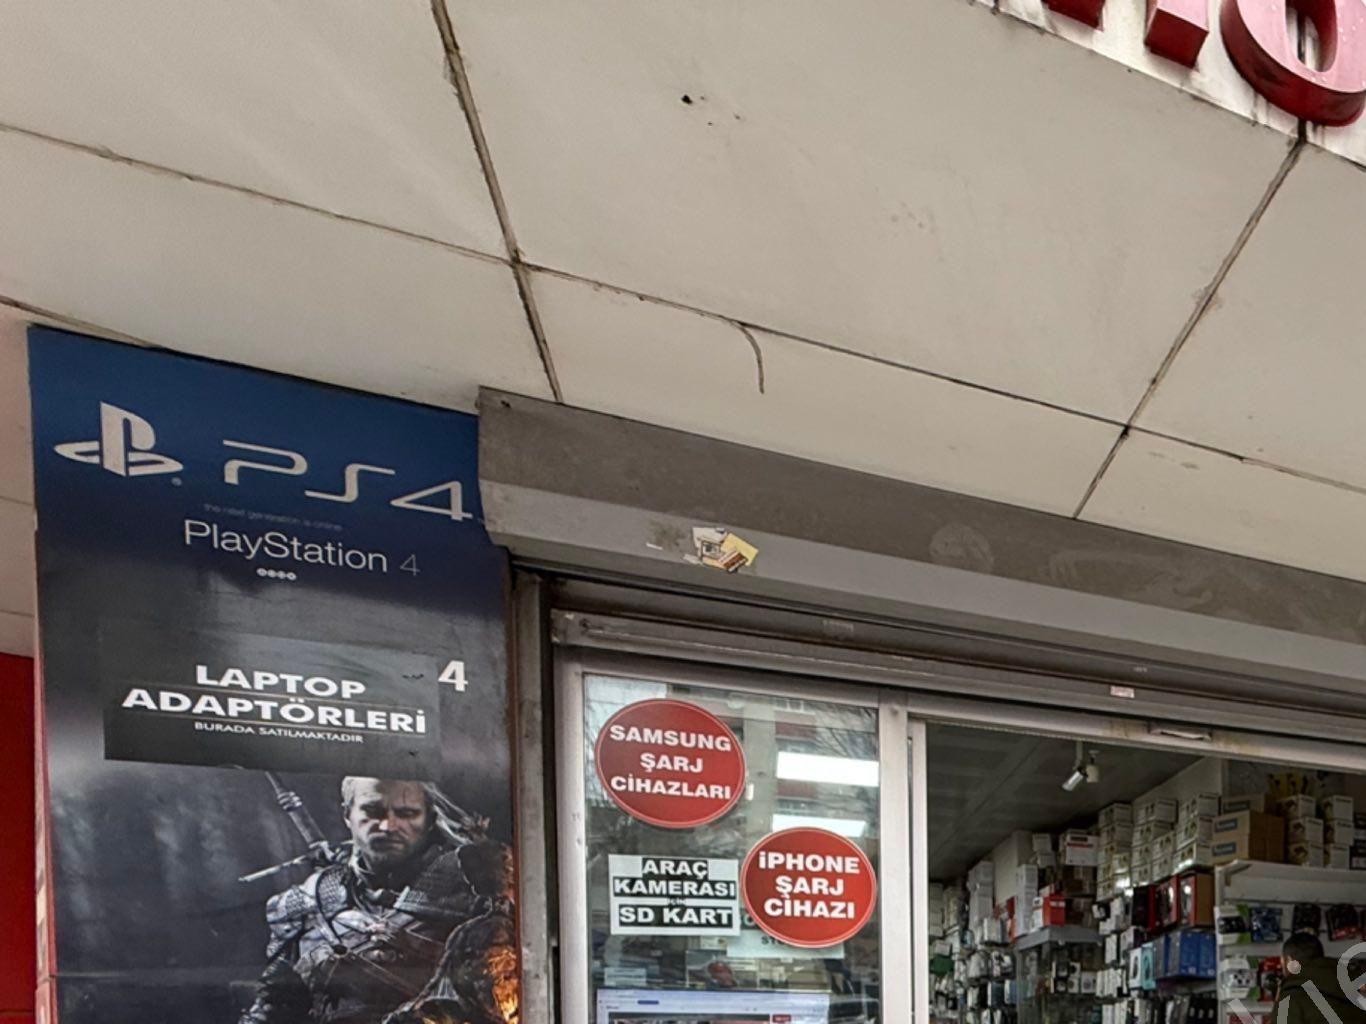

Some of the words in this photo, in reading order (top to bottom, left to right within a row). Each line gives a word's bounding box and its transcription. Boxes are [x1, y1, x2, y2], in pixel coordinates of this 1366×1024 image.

[222, 439, 473, 520] PS4
[184, 519, 388, 573] PlayStation
[400, 554, 421, 577] 4
[196, 665, 366, 699] LAPTOP
[438, 660, 468, 692] 4
[121, 688, 426, 734] ADAPTÖRLERİ
[194, 721, 254, 735] BURADA
[259, 727, 364, 743] SATILMAKTADIR
[609, 724, 732, 752] SAMSUNG
[640, 753, 704, 774] ŞARJ
[610, 774, 732, 800] CİHAZLARI
[642, 860, 708, 880] ARAÇ
[614, 879, 735, 896] KAMERASI
[775, 875, 845, 900] ŞARJ
[620, 907, 655, 922] SD
[663, 907, 732, 925] KART
[763, 894, 855, 920] CİHAZI
